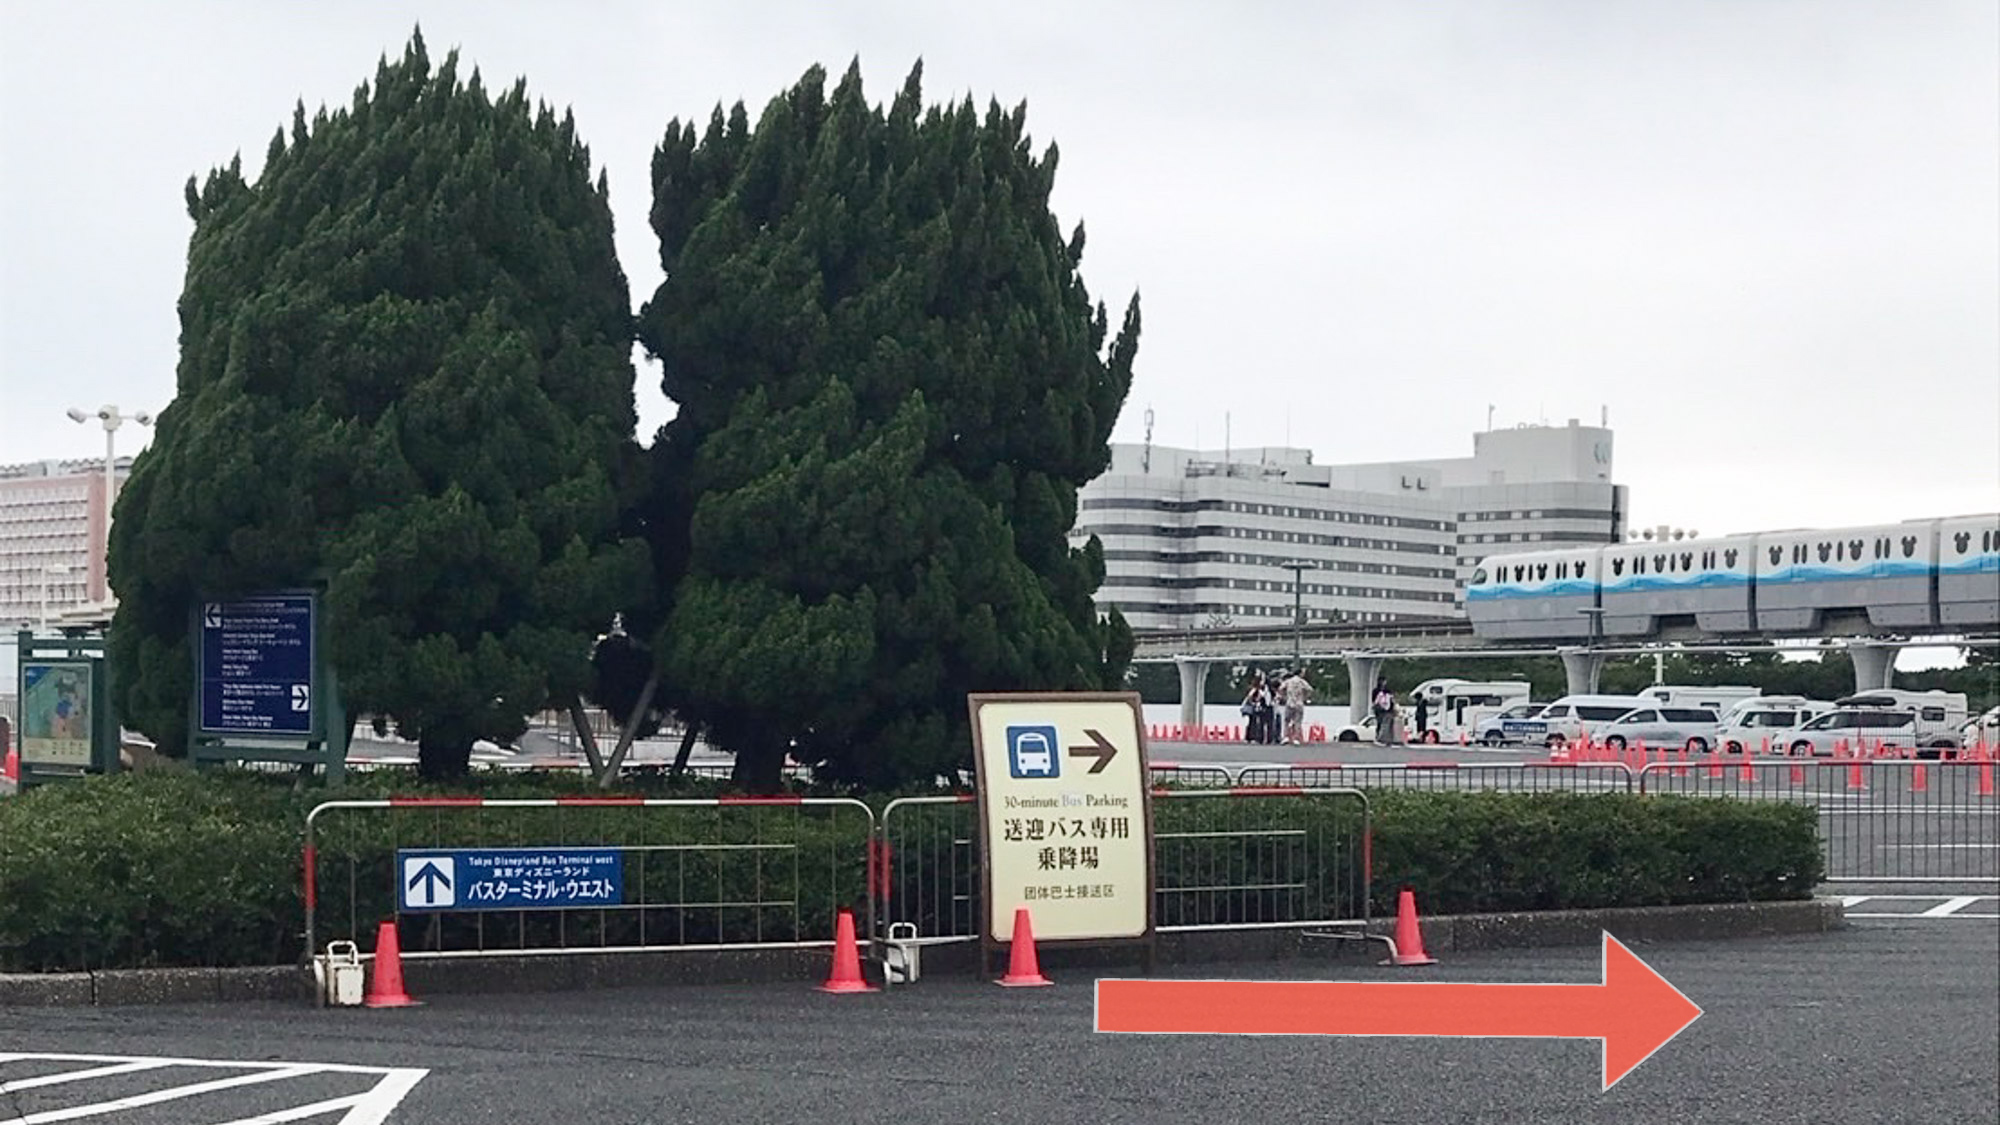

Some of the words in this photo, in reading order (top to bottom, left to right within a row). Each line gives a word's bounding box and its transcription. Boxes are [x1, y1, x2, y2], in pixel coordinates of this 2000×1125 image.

[1004, 796, 1059, 808] 30-minute
[1062, 794, 1082, 807] Bus
[1086, 794, 1129, 808] Parking
[1004, 817, 1129, 842] 送迎バス専用
[468, 856, 492, 867] Tokyo
[494, 856, 540, 866] Disneyland
[542, 855, 557, 865] Bus
[559, 855, 593, 865] Terminal
[595, 855, 613, 864] west
[1037, 846, 1099, 870] 乗降場
[493, 867, 590, 878] 東京ディズニーランド
[1024, 885, 1114, 899] 团体巴士接送区
